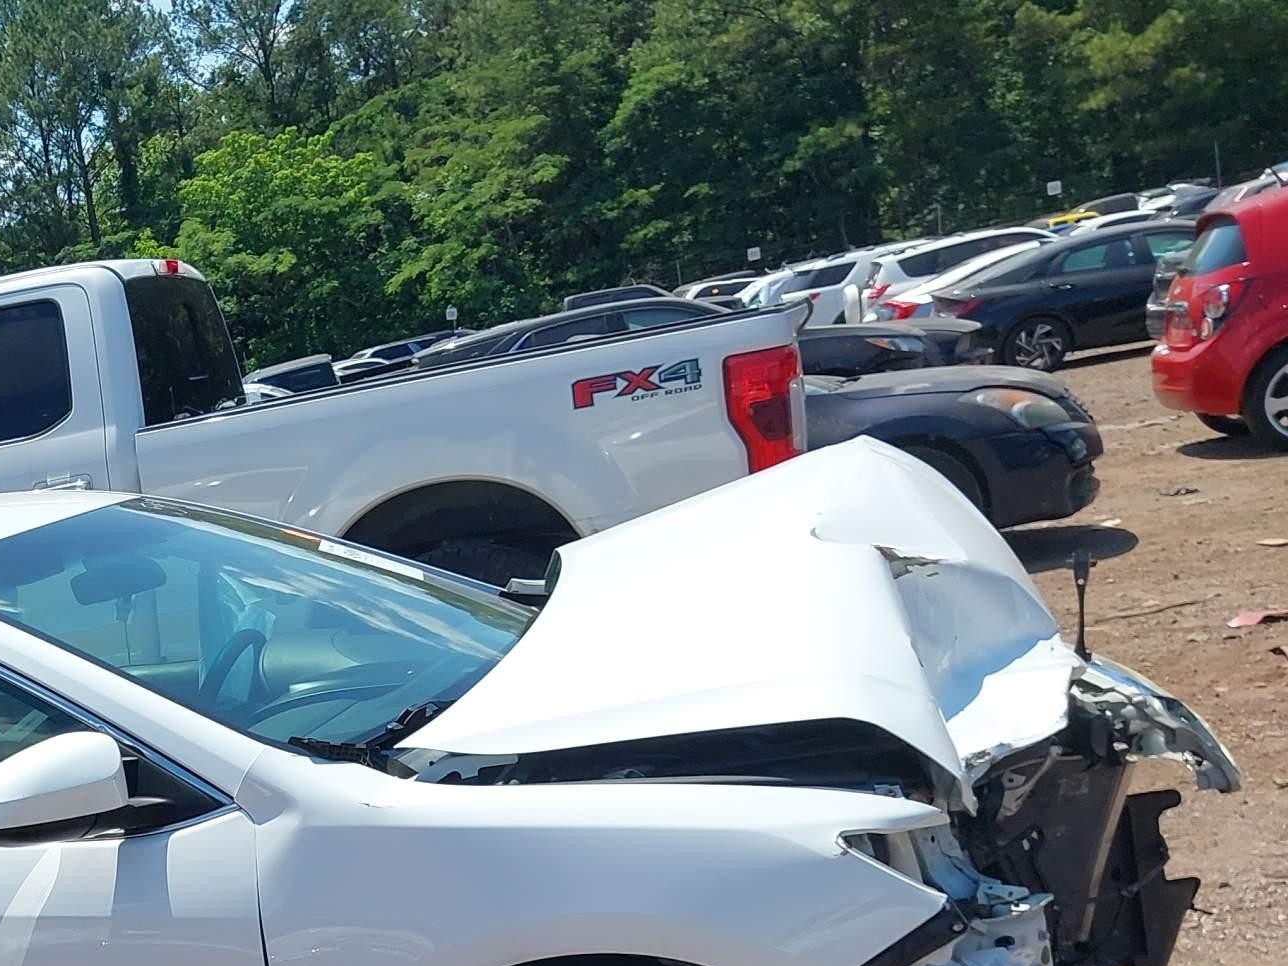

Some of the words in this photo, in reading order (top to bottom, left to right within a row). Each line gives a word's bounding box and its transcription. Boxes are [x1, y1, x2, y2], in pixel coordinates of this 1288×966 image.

[571, 358, 702, 409] FX4
[631, 391, 659, 402] OFF
[664, 384, 703, 396] ROAD
